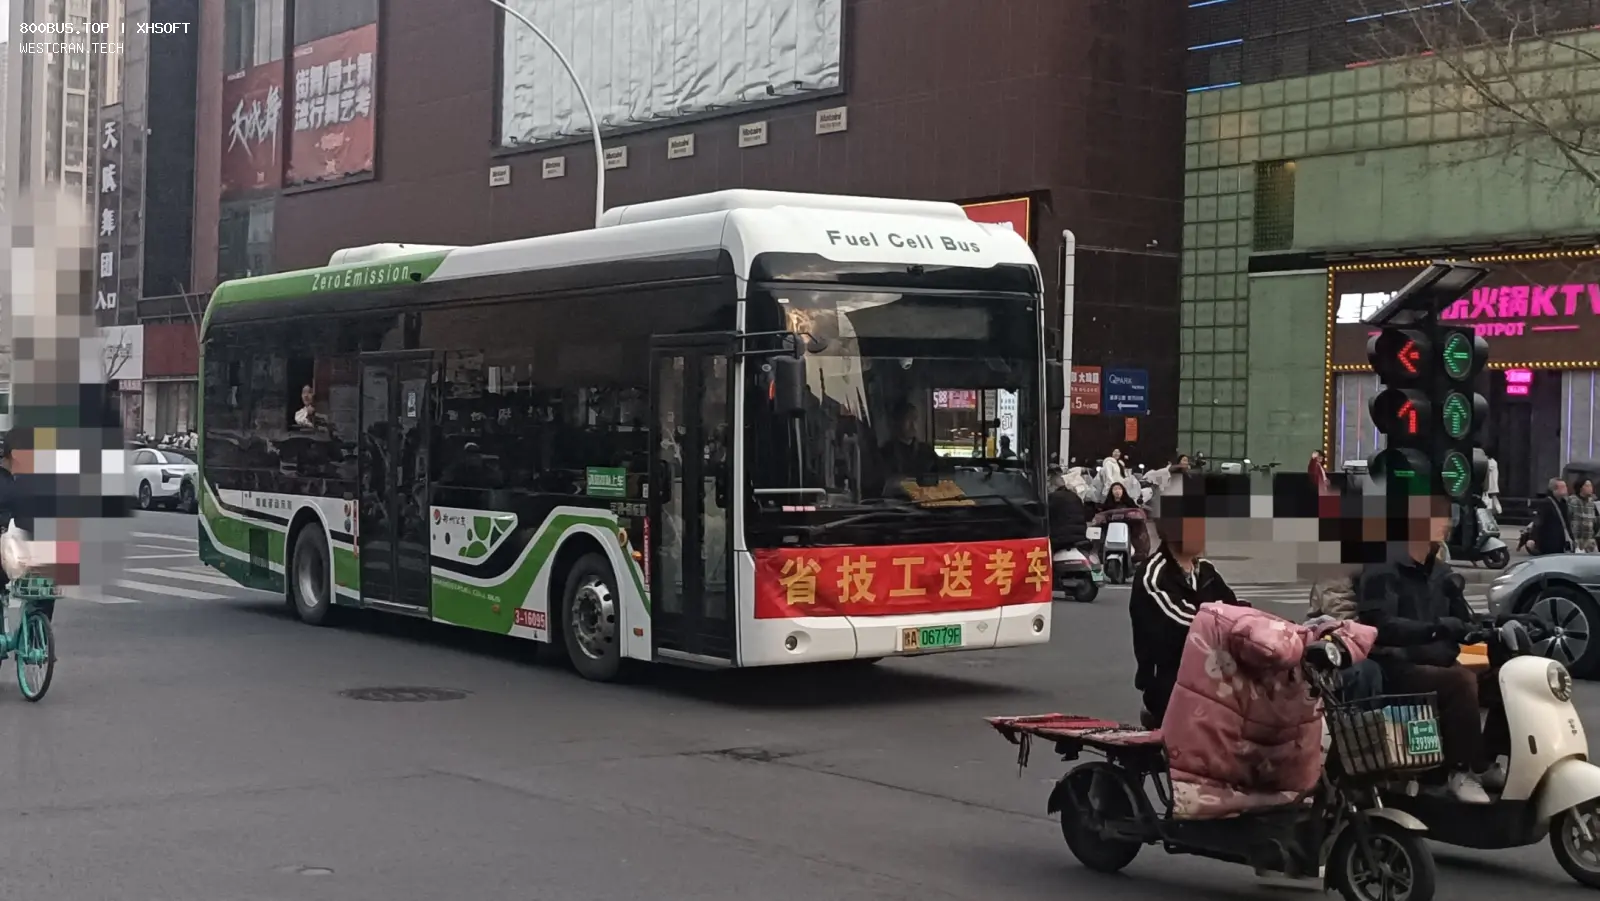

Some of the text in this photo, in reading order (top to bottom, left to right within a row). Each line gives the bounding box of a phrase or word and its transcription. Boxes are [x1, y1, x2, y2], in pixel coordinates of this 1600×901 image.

[826, 230, 981, 253] Fuel Cell Bus
[312, 263, 409, 291] Zero Emission
[95, 290, 116, 310] 入口
[779, 546, 1049, 606] 省技工送考车
[515, 609, 545, 628] 3-16095
